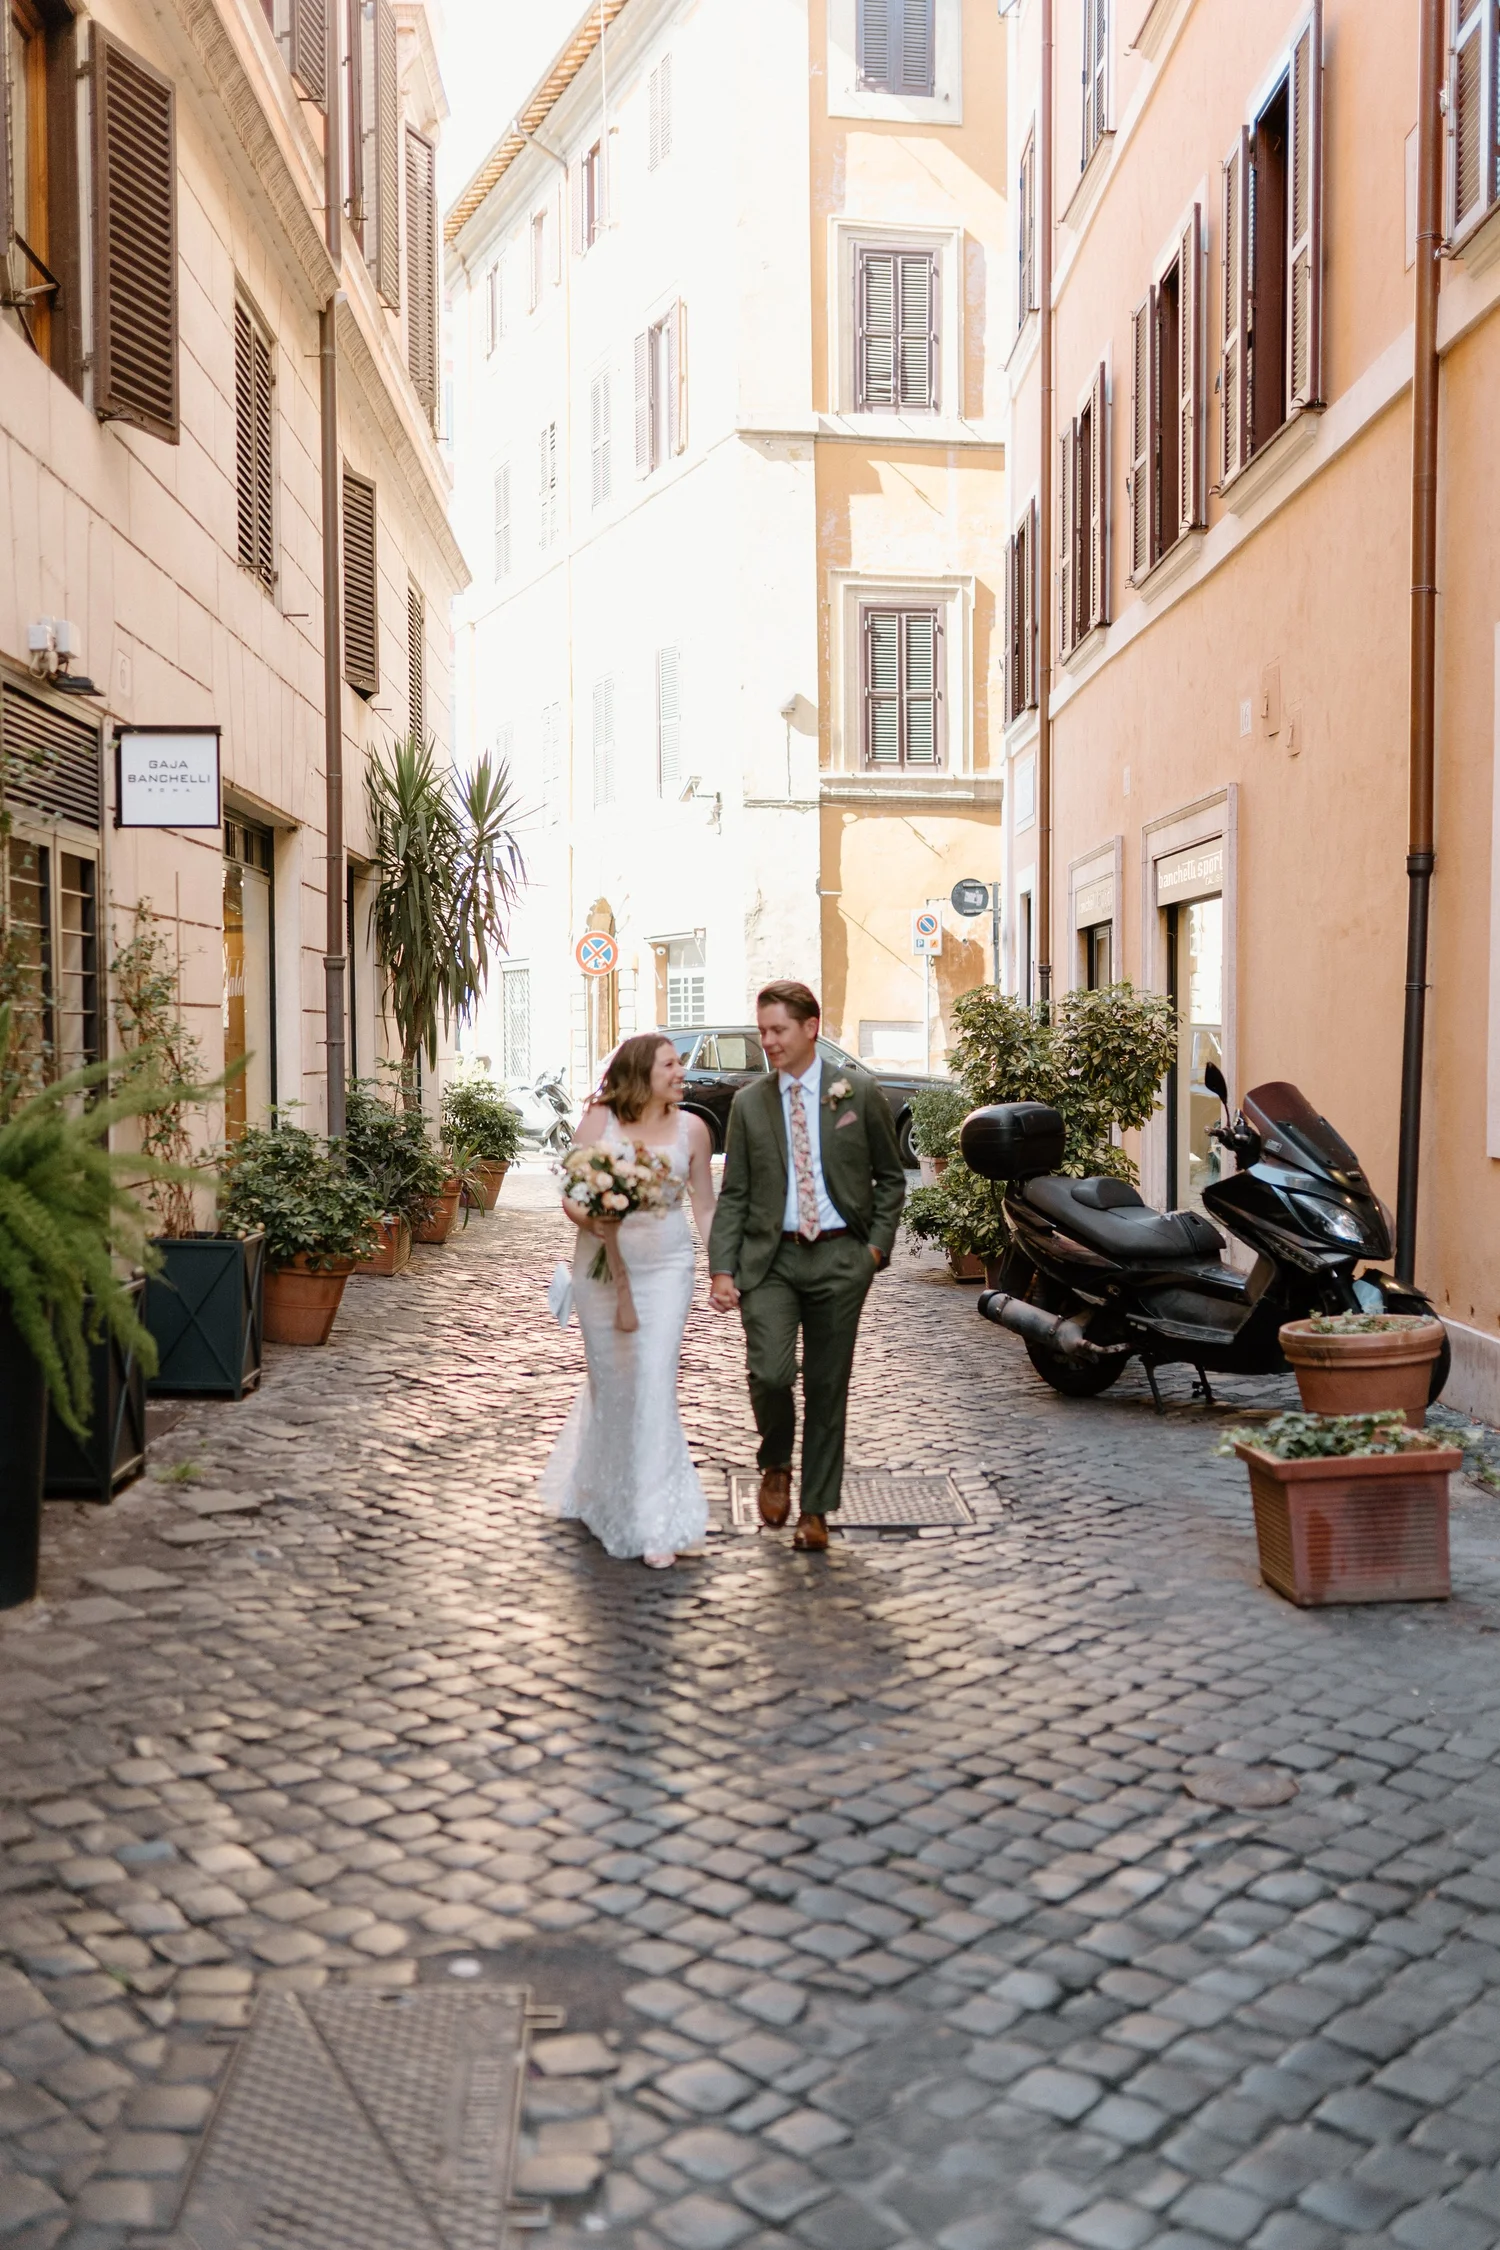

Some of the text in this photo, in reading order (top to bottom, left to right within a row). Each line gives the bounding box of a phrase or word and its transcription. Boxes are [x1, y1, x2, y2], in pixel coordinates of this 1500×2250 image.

[148, 760, 189, 769] GAJA
[127, 774, 210, 783] BANCHELLI
[1197, 849, 1223, 879] sport
[917, 939, 924, 947] P
